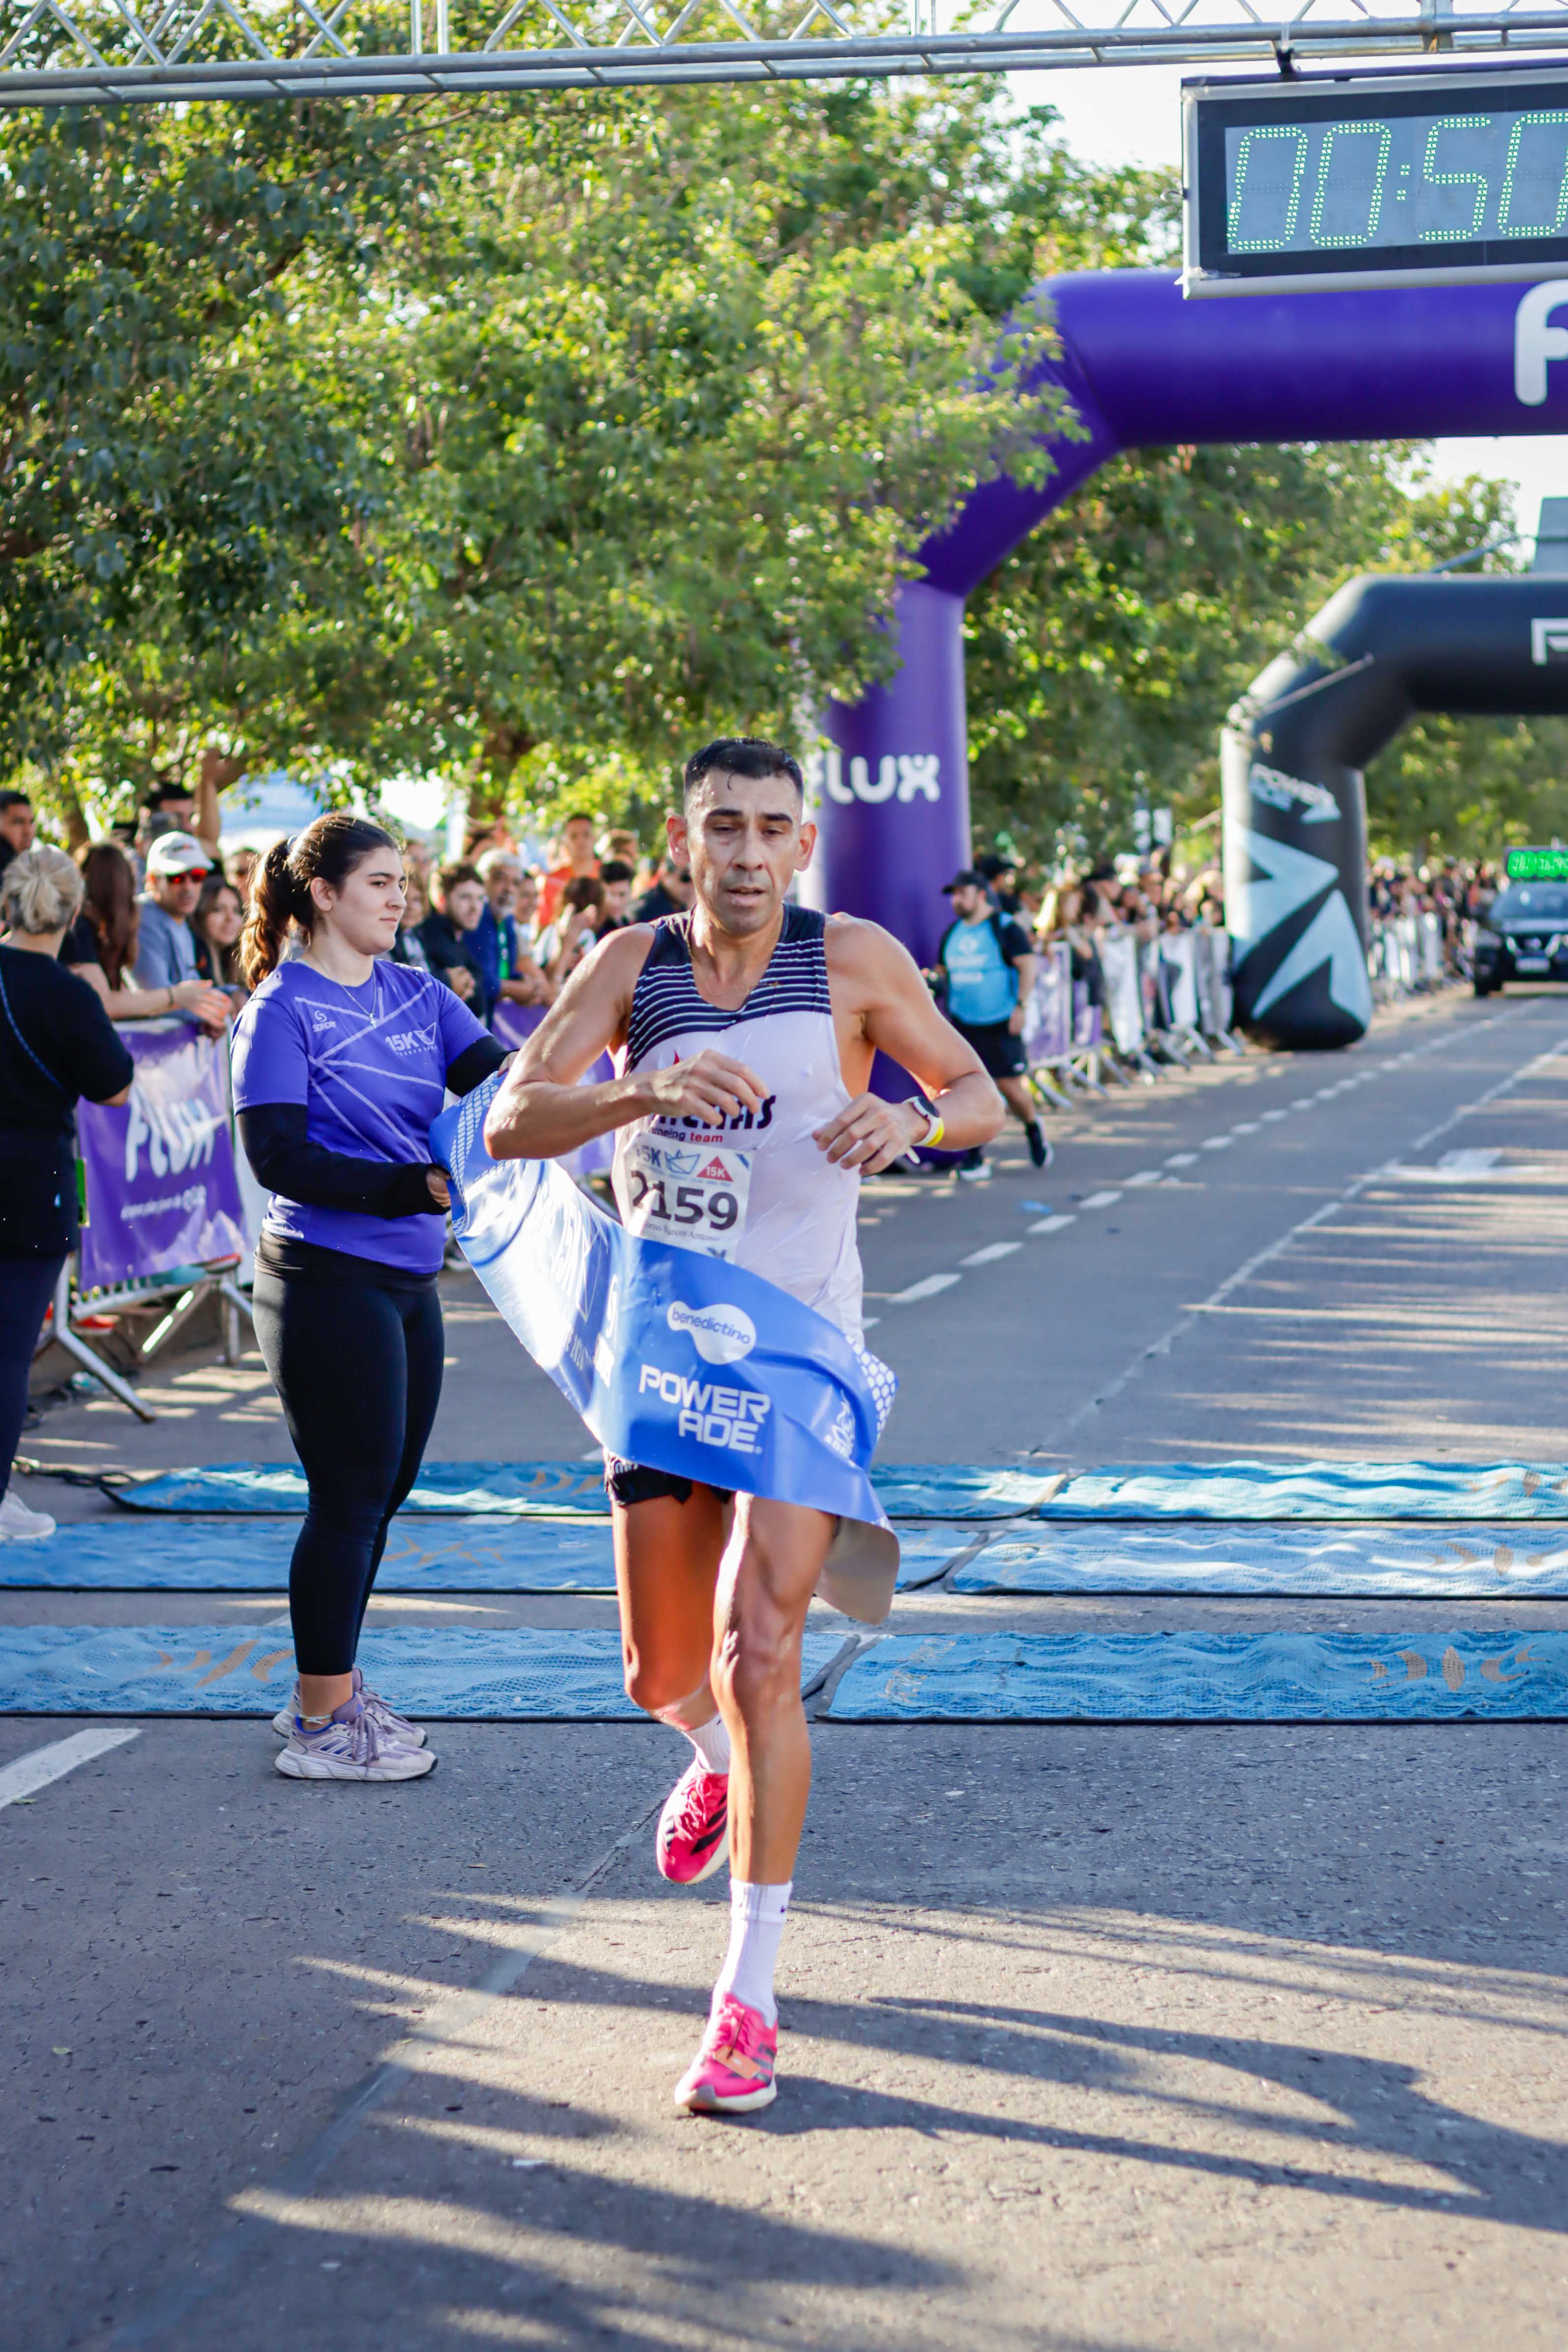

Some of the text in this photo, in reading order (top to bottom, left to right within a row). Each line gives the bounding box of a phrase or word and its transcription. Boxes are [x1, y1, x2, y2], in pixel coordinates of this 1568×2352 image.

[385, 1031, 419, 1051] 15K
[690, 1132, 723, 1143] team
[706, 1166, 725, 1177] 15K
[672, 1307, 751, 1345] benedictino
[638, 1364, 770, 1424] POWER
[679, 1409, 760, 1453] ADE
